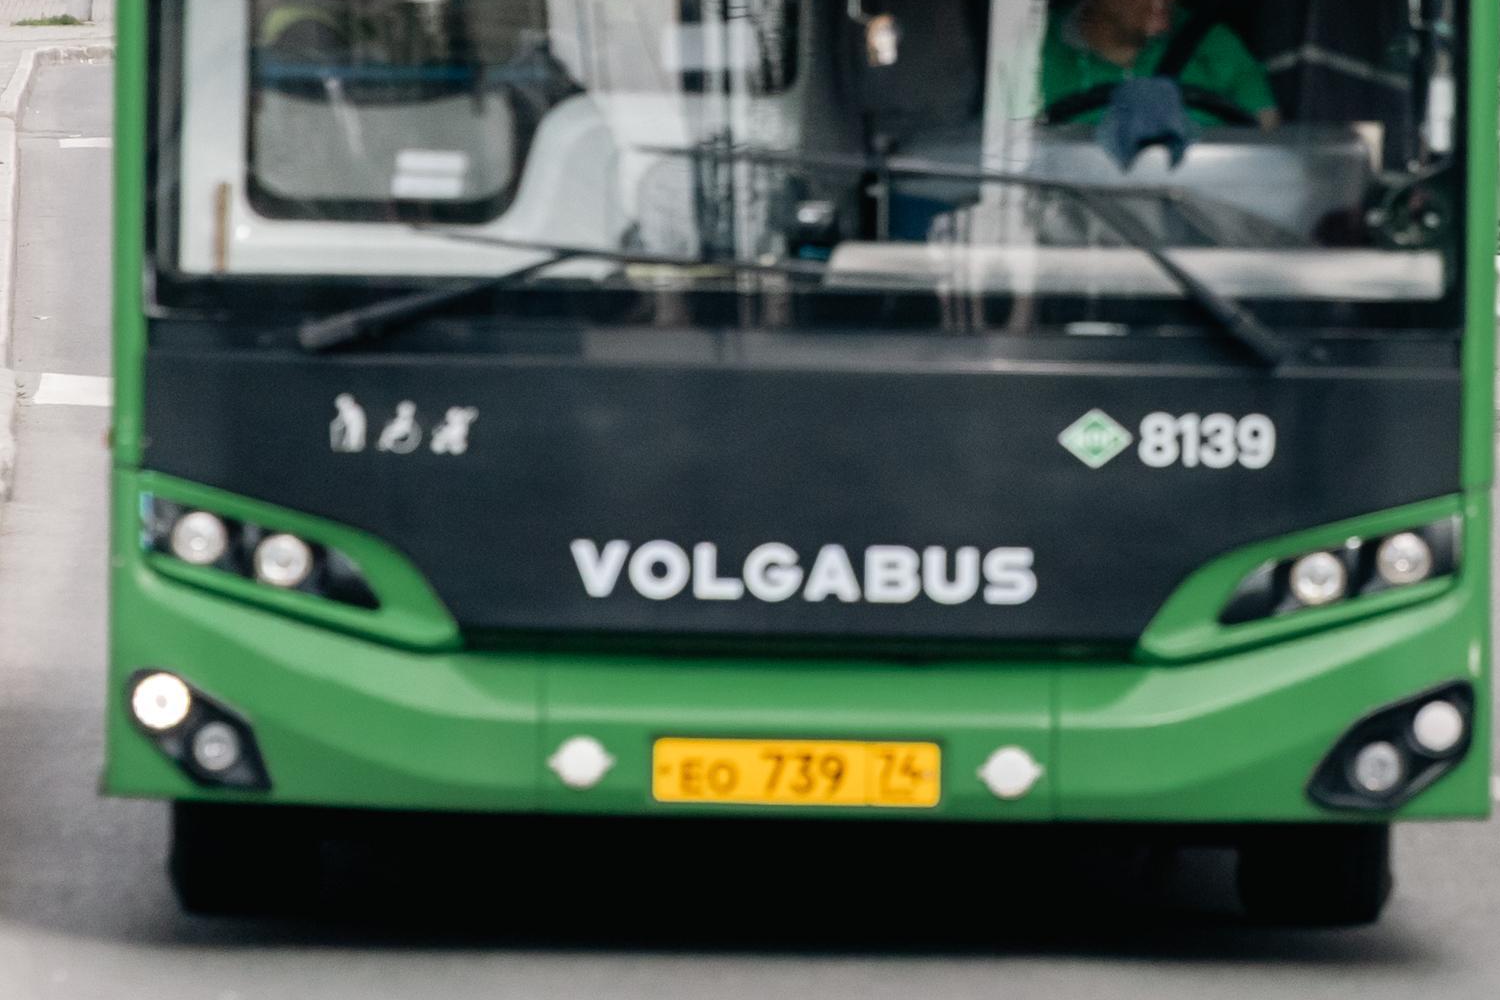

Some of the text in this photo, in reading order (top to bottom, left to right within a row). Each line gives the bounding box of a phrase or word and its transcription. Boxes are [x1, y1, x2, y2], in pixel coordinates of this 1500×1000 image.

[1137, 411, 1277, 469] 8139
[570, 539, 1037, 604] VOLGABUS
[680, 750, 923, 798] ЕО 739 74
